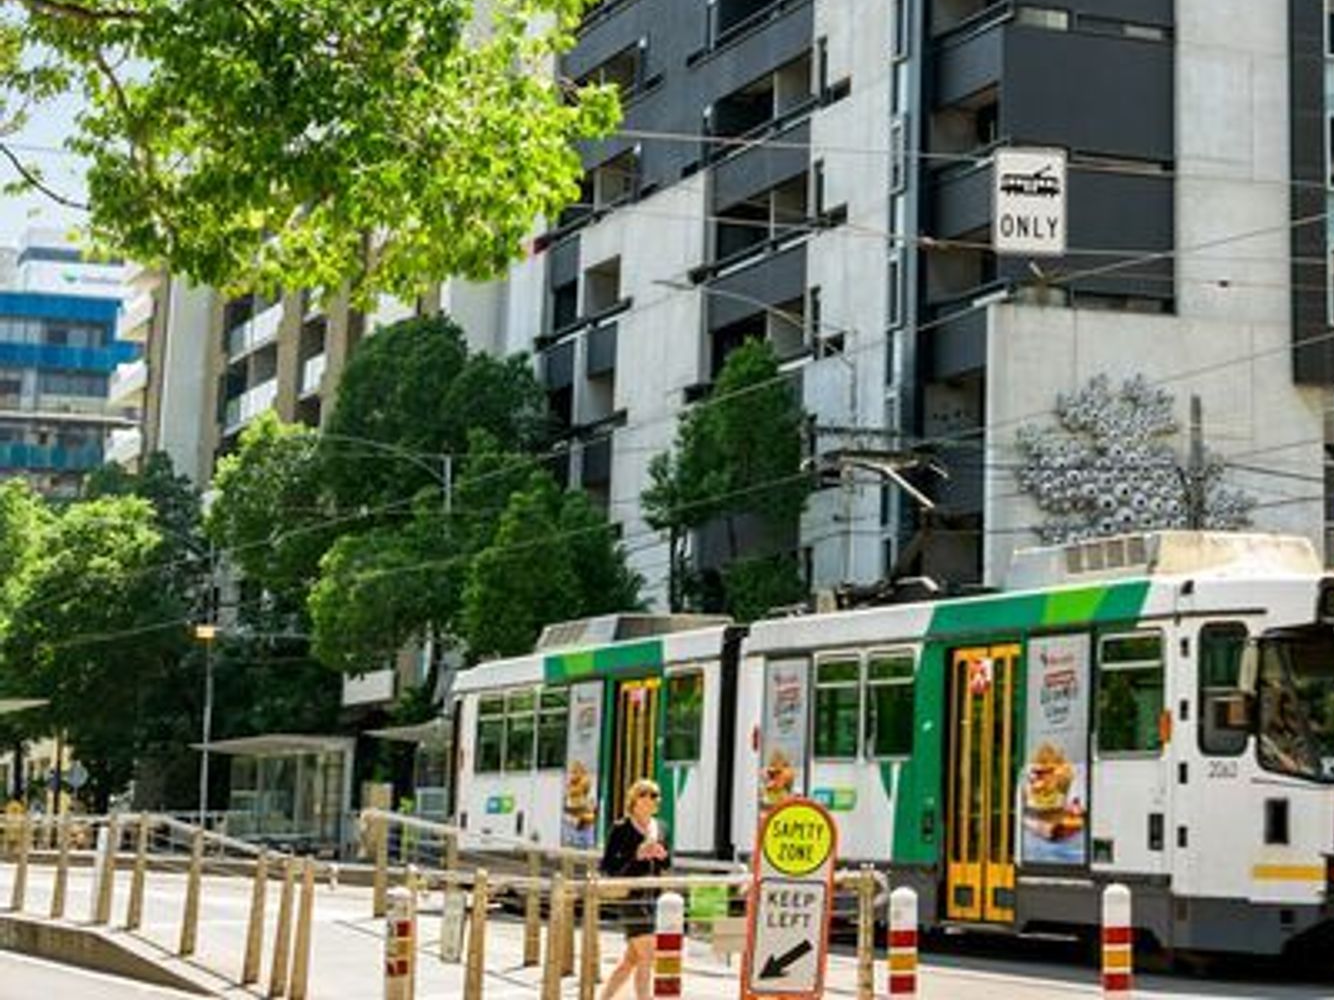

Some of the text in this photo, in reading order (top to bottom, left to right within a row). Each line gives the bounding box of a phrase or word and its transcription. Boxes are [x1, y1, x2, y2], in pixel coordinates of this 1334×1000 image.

[1000, 213, 1058, 239] ONLY
[772, 819, 825, 841] SAFETY
[776, 842, 815, 863] ZONE
[767, 889, 816, 909] KEEP
[766, 912, 812, 929] LEFT
